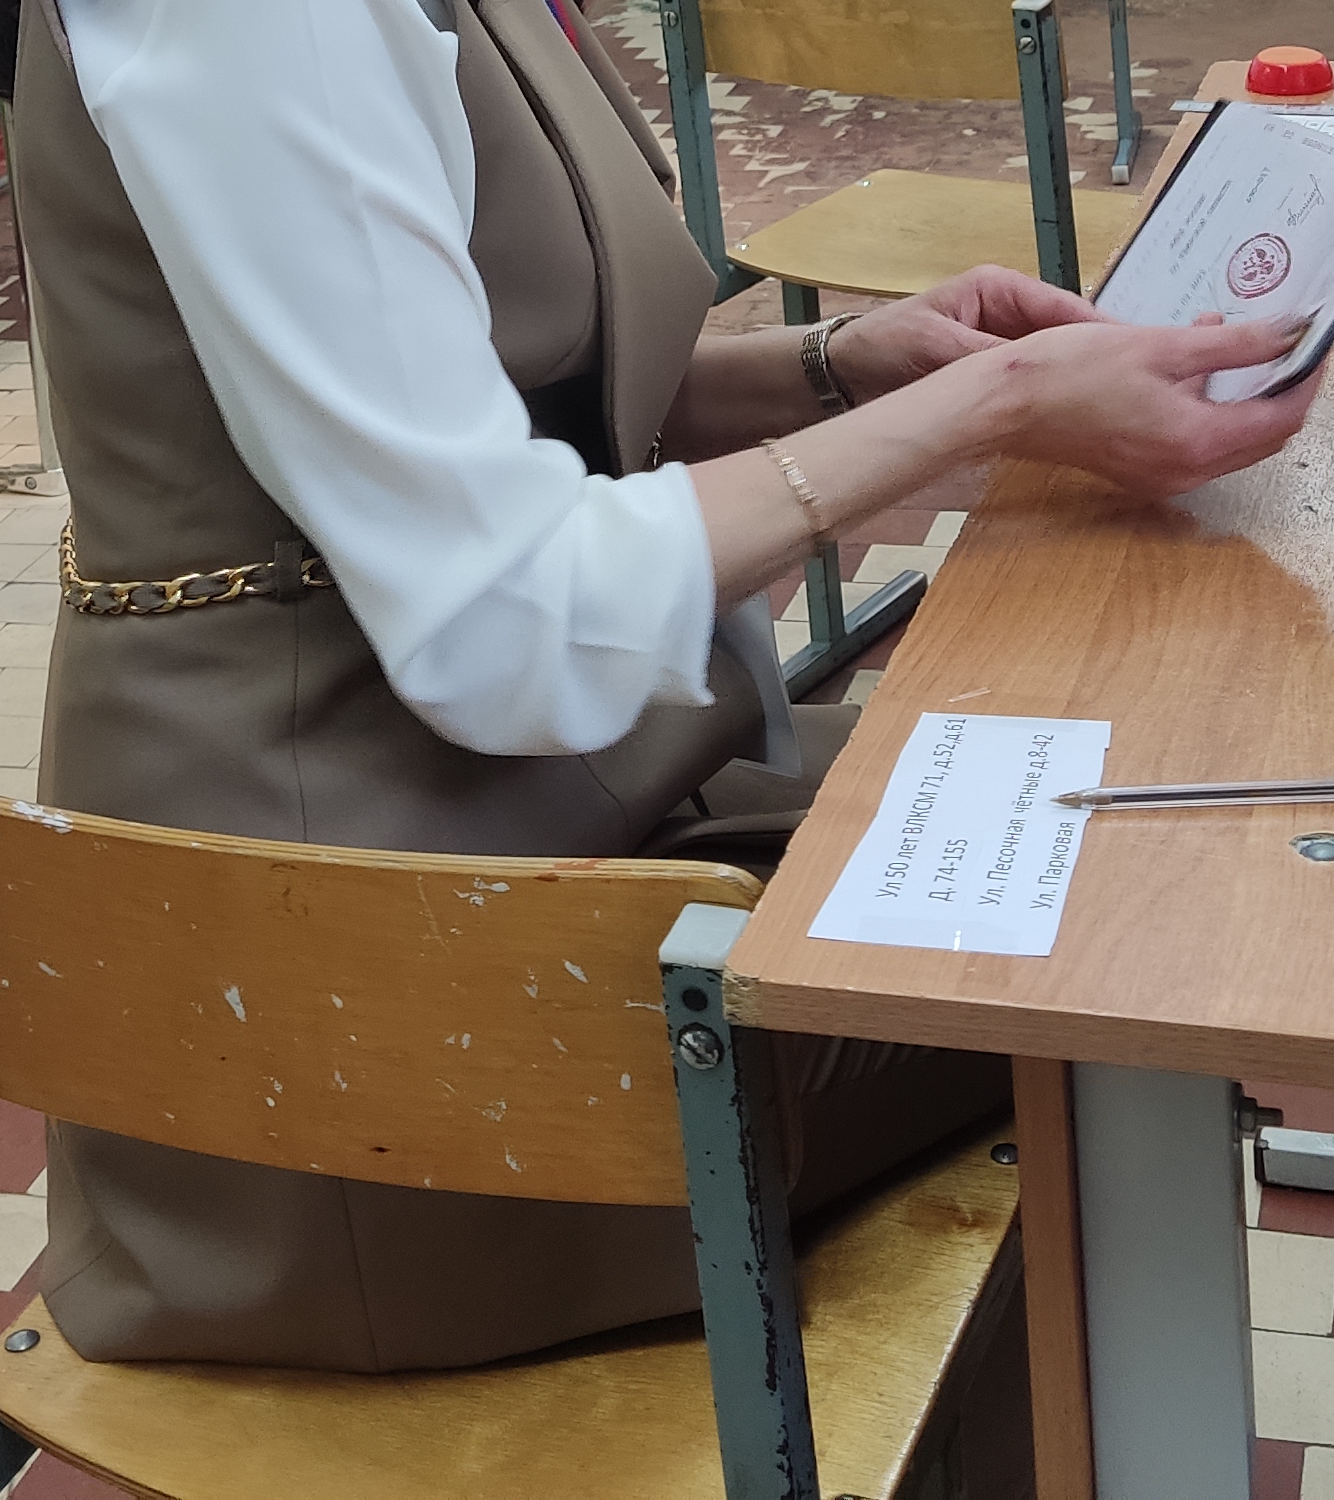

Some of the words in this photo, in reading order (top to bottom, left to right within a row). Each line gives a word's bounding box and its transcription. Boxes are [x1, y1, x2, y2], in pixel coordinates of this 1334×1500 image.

[921, 771, 949, 790] 71,
[1010, 771, 1042, 813] чётные
[902, 792, 937, 835] ВЛКСМ
[899, 837, 919, 861] лет
[934, 838, 968, 883] 74-155
[987, 820, 1027, 882] Песочная
[1038, 821, 1076, 885] Парковая
[885, 862, 909, 879] 50
[875, 881, 902, 898] Ул
[928, 884, 954, 902] Д.
[978, 884, 1005, 906] Ул.
[1029, 889, 1056, 910] Ул.
